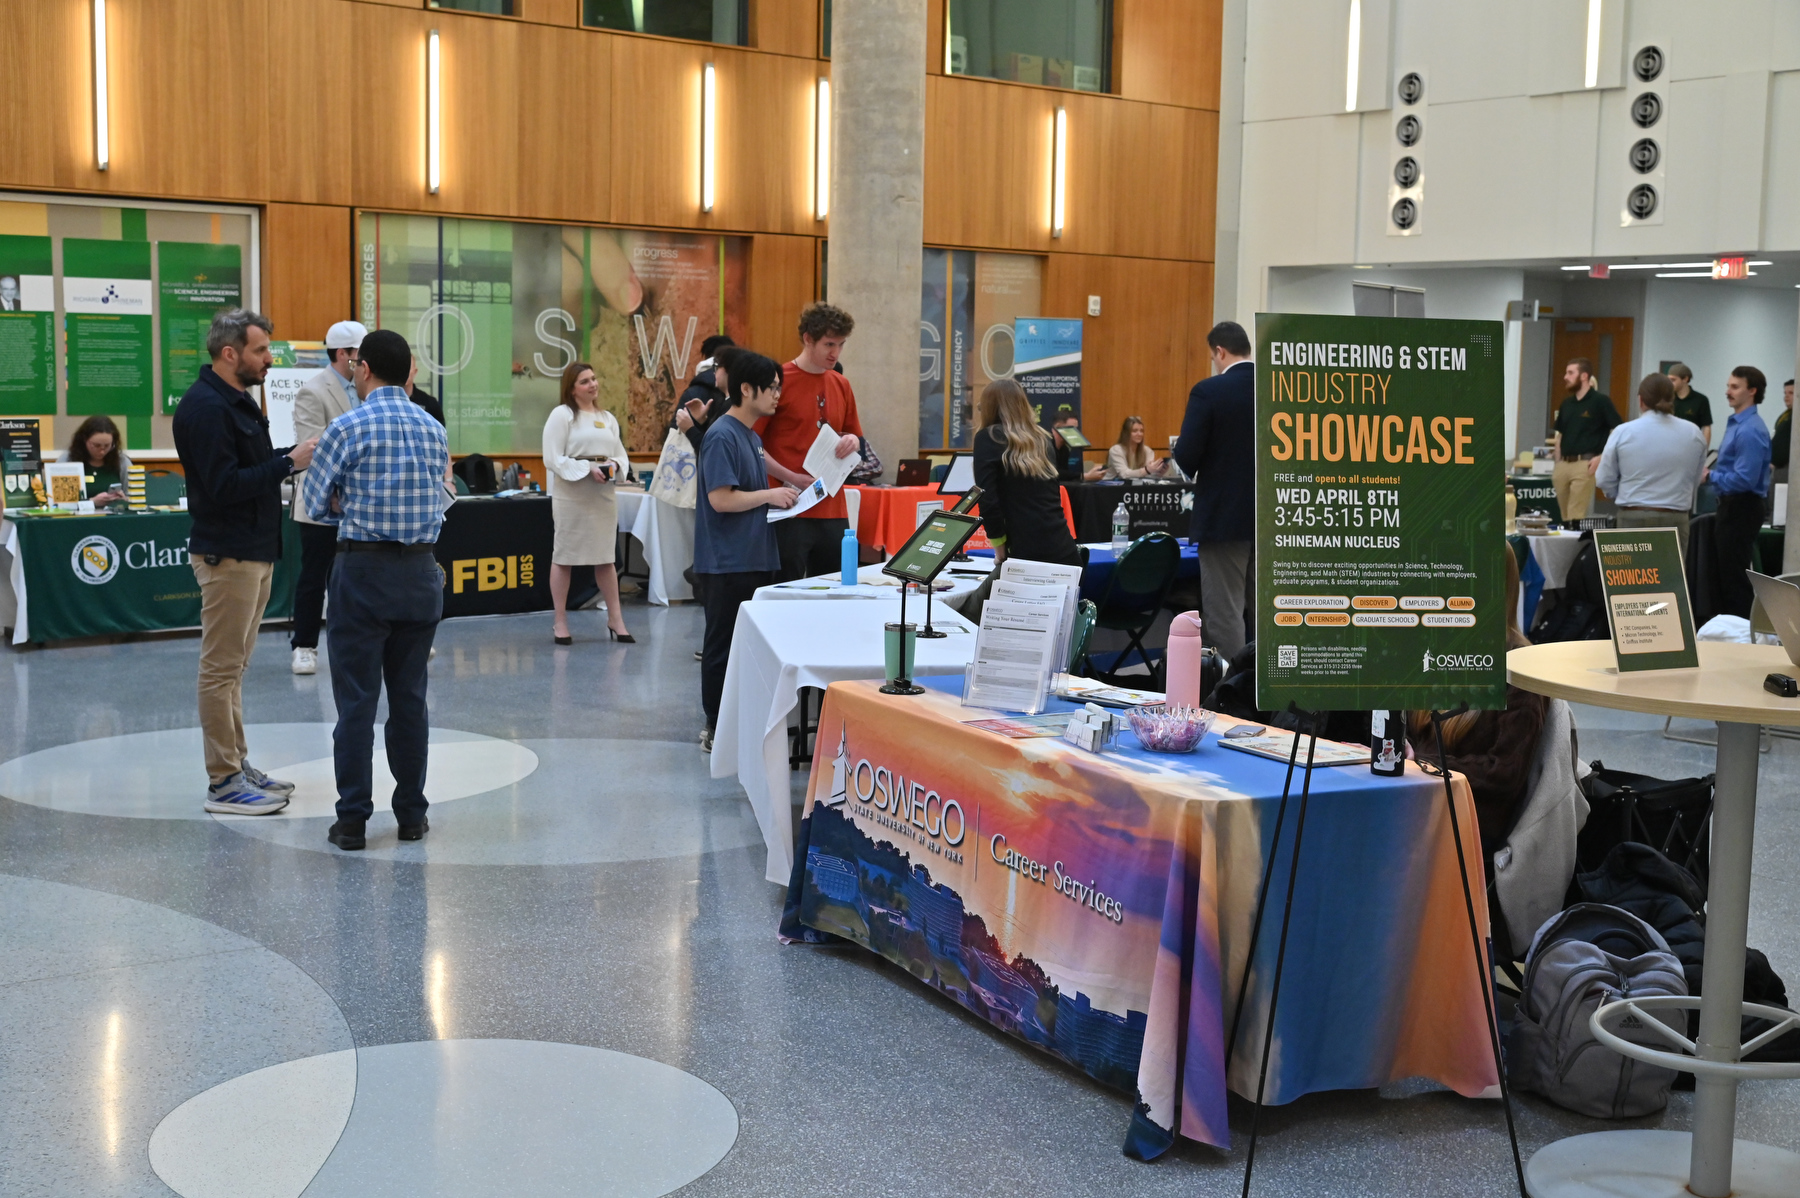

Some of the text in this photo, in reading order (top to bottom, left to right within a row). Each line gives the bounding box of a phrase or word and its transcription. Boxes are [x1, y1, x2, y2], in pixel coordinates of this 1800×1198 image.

[633, 247, 679, 260] progress
[363, 242, 375, 330] RESOURCES
[981, 284, 1008, 294] natural
[416, 304, 698, 379] O S W
[1270, 342, 1466, 371] ENGINEERING & STEM
[270, 380, 291, 388] ACE
[952, 330, 962, 438] WATER EFFICIENCY
[1272, 370, 1392, 405] INDUSTRY
[1270, 412, 1475, 465] SHOWCASE
[1274, 473, 1400, 485] FREE and open to all students!
[1123, 492, 1180, 504] GRIFFISS
[1276, 488, 1398, 506] WED APRIL 8TH
[1517, 488, 1557, 499] STUDIES
[1274, 506, 1400, 528] 3:45-5:15 PM
[1275, 535, 1400, 548] SHINEMAN NUCLEUS
[1601, 544, 1634, 552] ENGINEERING
[1638, 543, 1652, 552] STEM
[1273, 561, 1291, 569] Swing
[1292, 561, 1299, 569] by
[1431, 563, 1464, 571] Technology,
[1603, 555, 1632, 566] INDUSTRY
[452, 554, 534, 594] FBI JOBS
[1273, 570, 1309, 578] Engineering,
[1606, 568, 1660, 586] SHOWCASE
[1436, 654, 1494, 667] OSWEGO
[854, 758, 966, 845] OSWEGO
[854, 803, 963, 864] STATE UNIVERSITY OF NEW YORK
[990, 833, 1122, 922] Career Services
